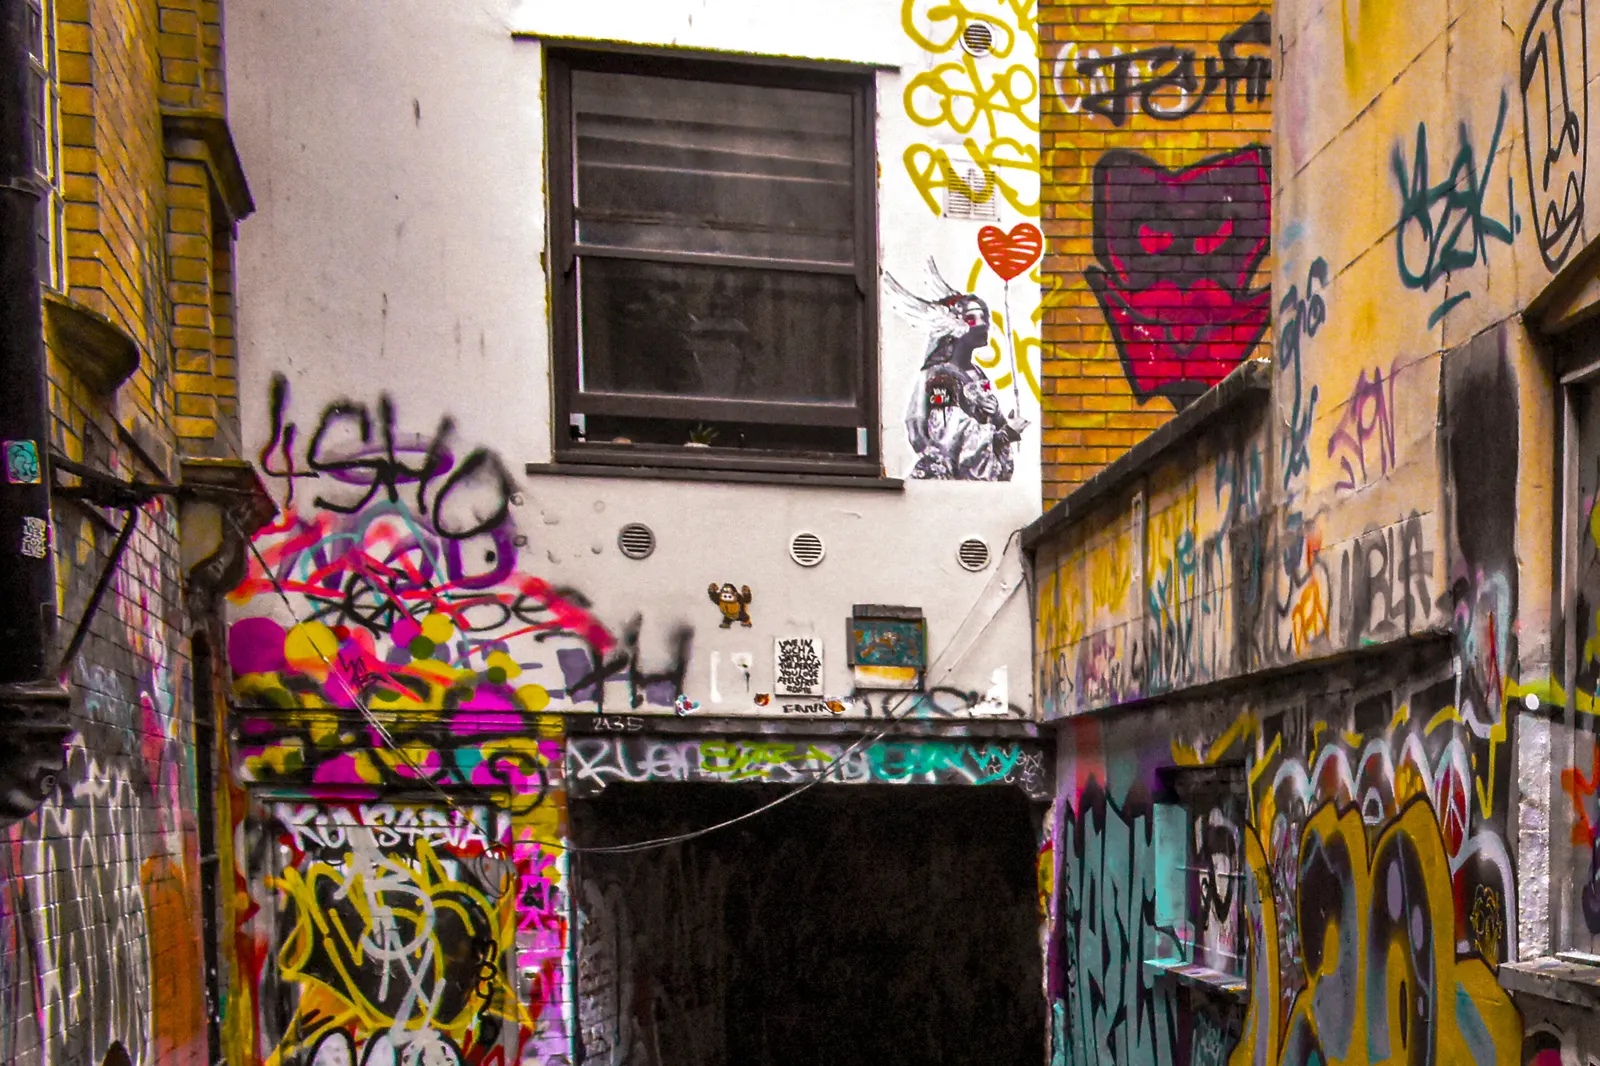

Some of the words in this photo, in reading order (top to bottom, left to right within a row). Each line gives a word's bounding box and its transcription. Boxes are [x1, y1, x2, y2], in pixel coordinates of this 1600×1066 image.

[778, 639, 798, 649] LOVE
[801, 639, 813, 648] IN
[781, 646, 805, 656] SUCH
[808, 646, 815, 654] A
[778, 662, 793, 670] THE
[799, 668, 819, 678] LOVE
[777, 676, 800, 686] FEELS
